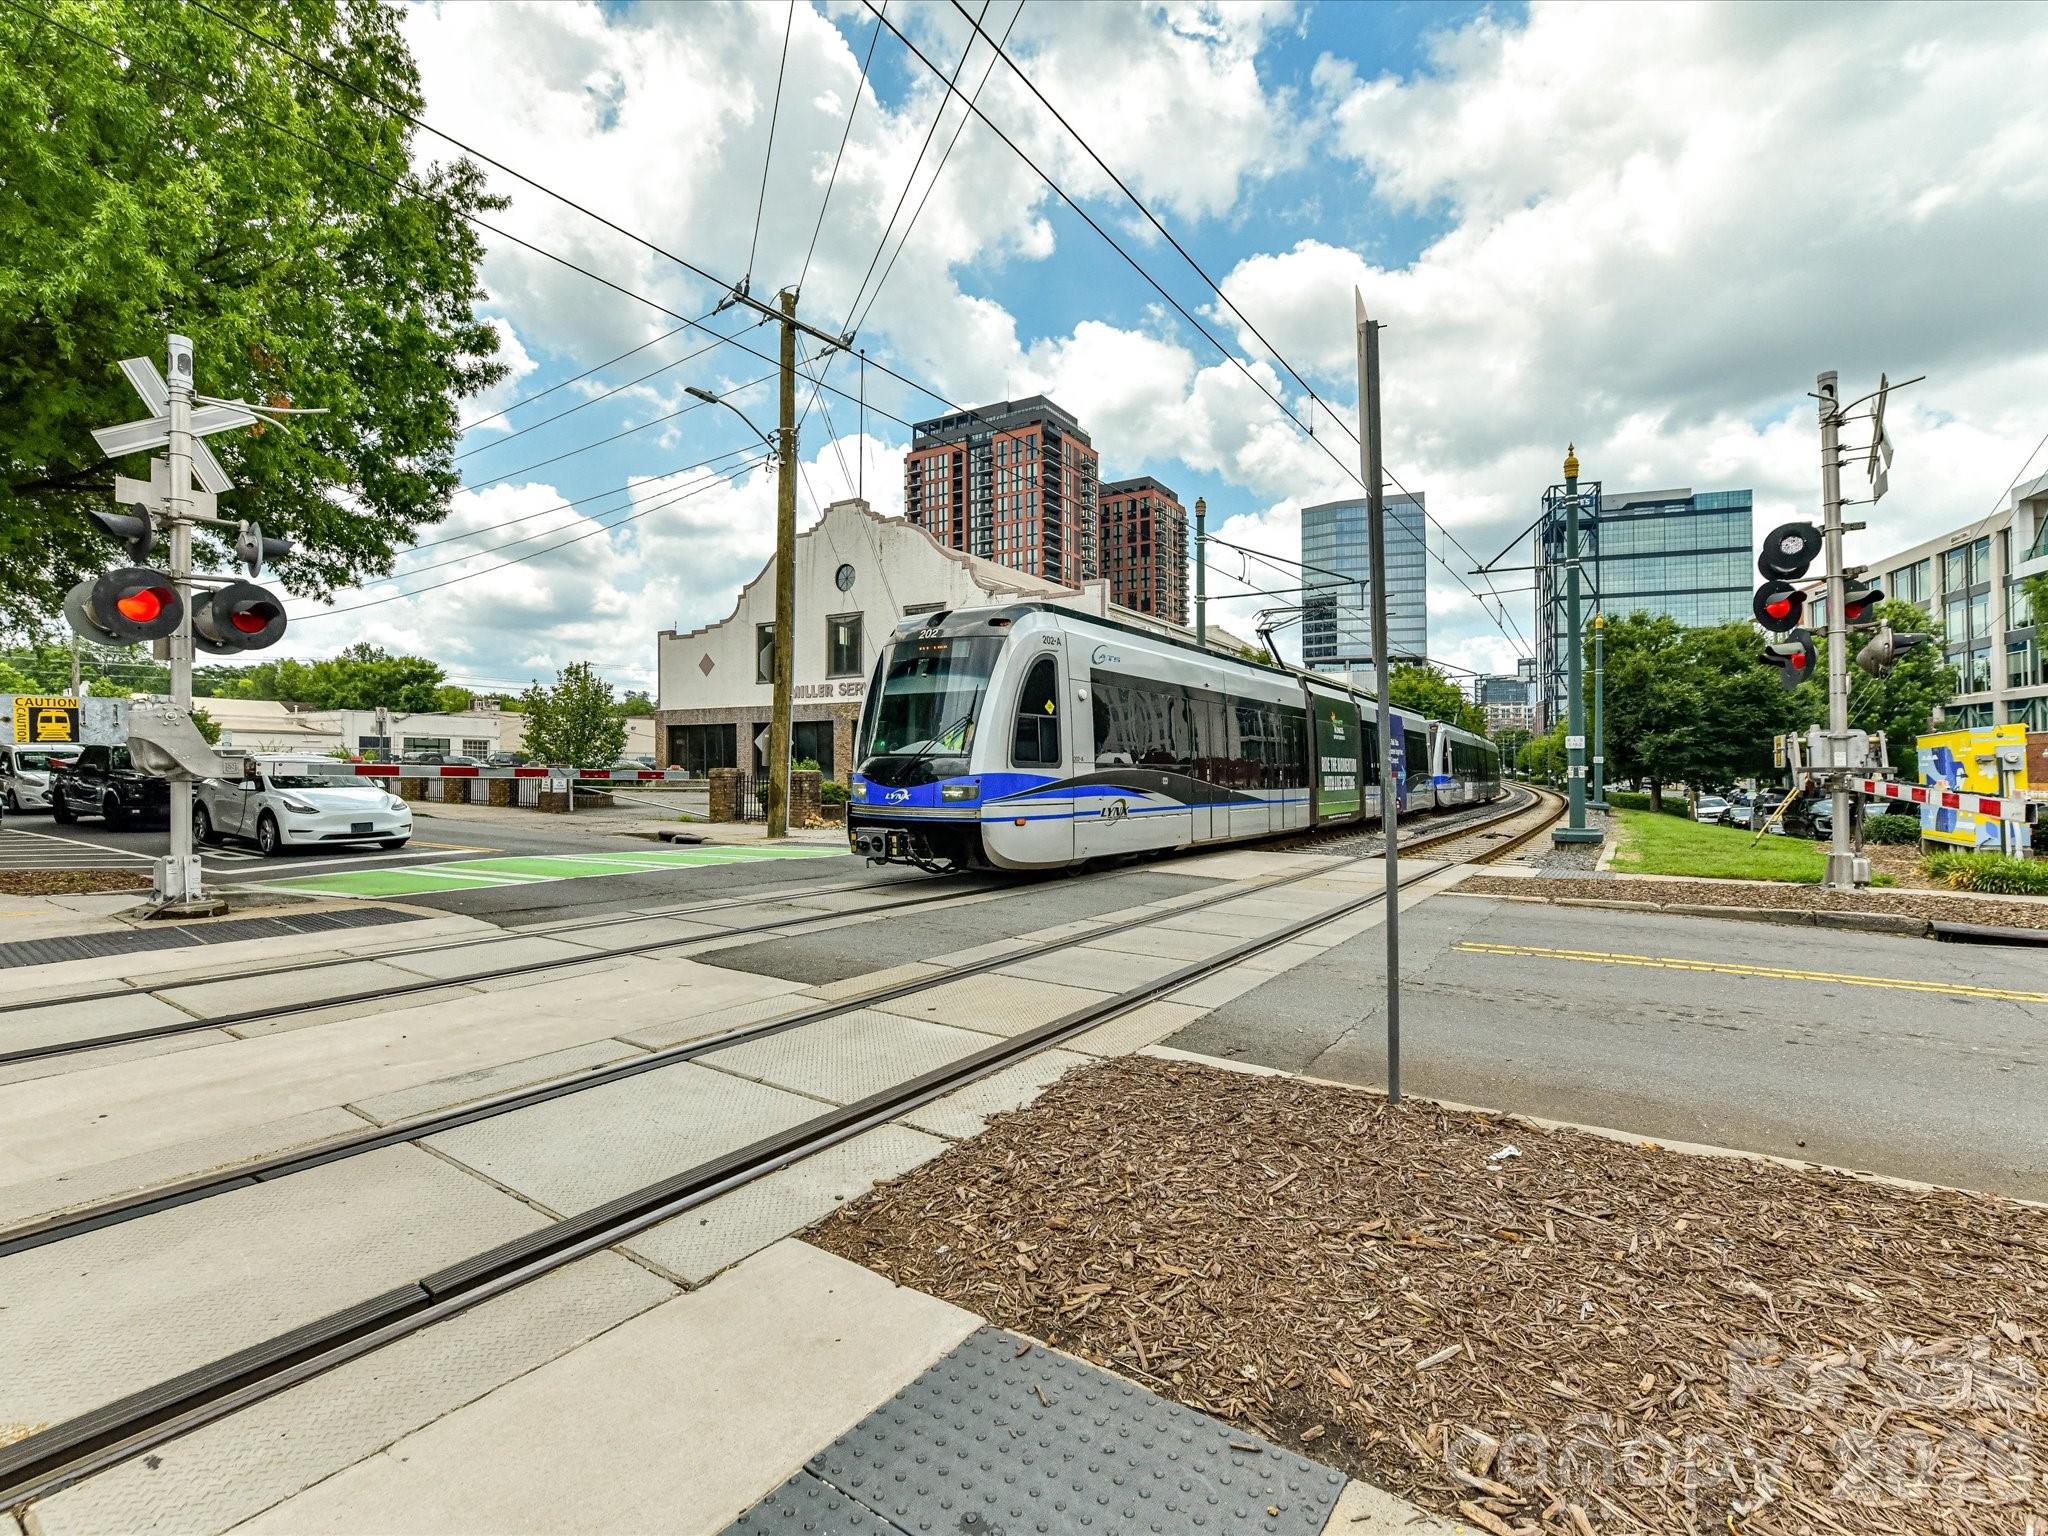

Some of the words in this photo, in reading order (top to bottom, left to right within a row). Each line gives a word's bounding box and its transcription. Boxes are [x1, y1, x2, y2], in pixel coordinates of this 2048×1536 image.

[918, 628, 939, 640] 202
[1042, 635, 1062, 647] 202-A
[793, 683, 834, 699] MILLER
[15, 697, 77, 707] CAUTION
[16, 707, 27, 743] CAUTION
[884, 790, 913, 802] LYNX
[1100, 804, 1130, 819] LYNX
